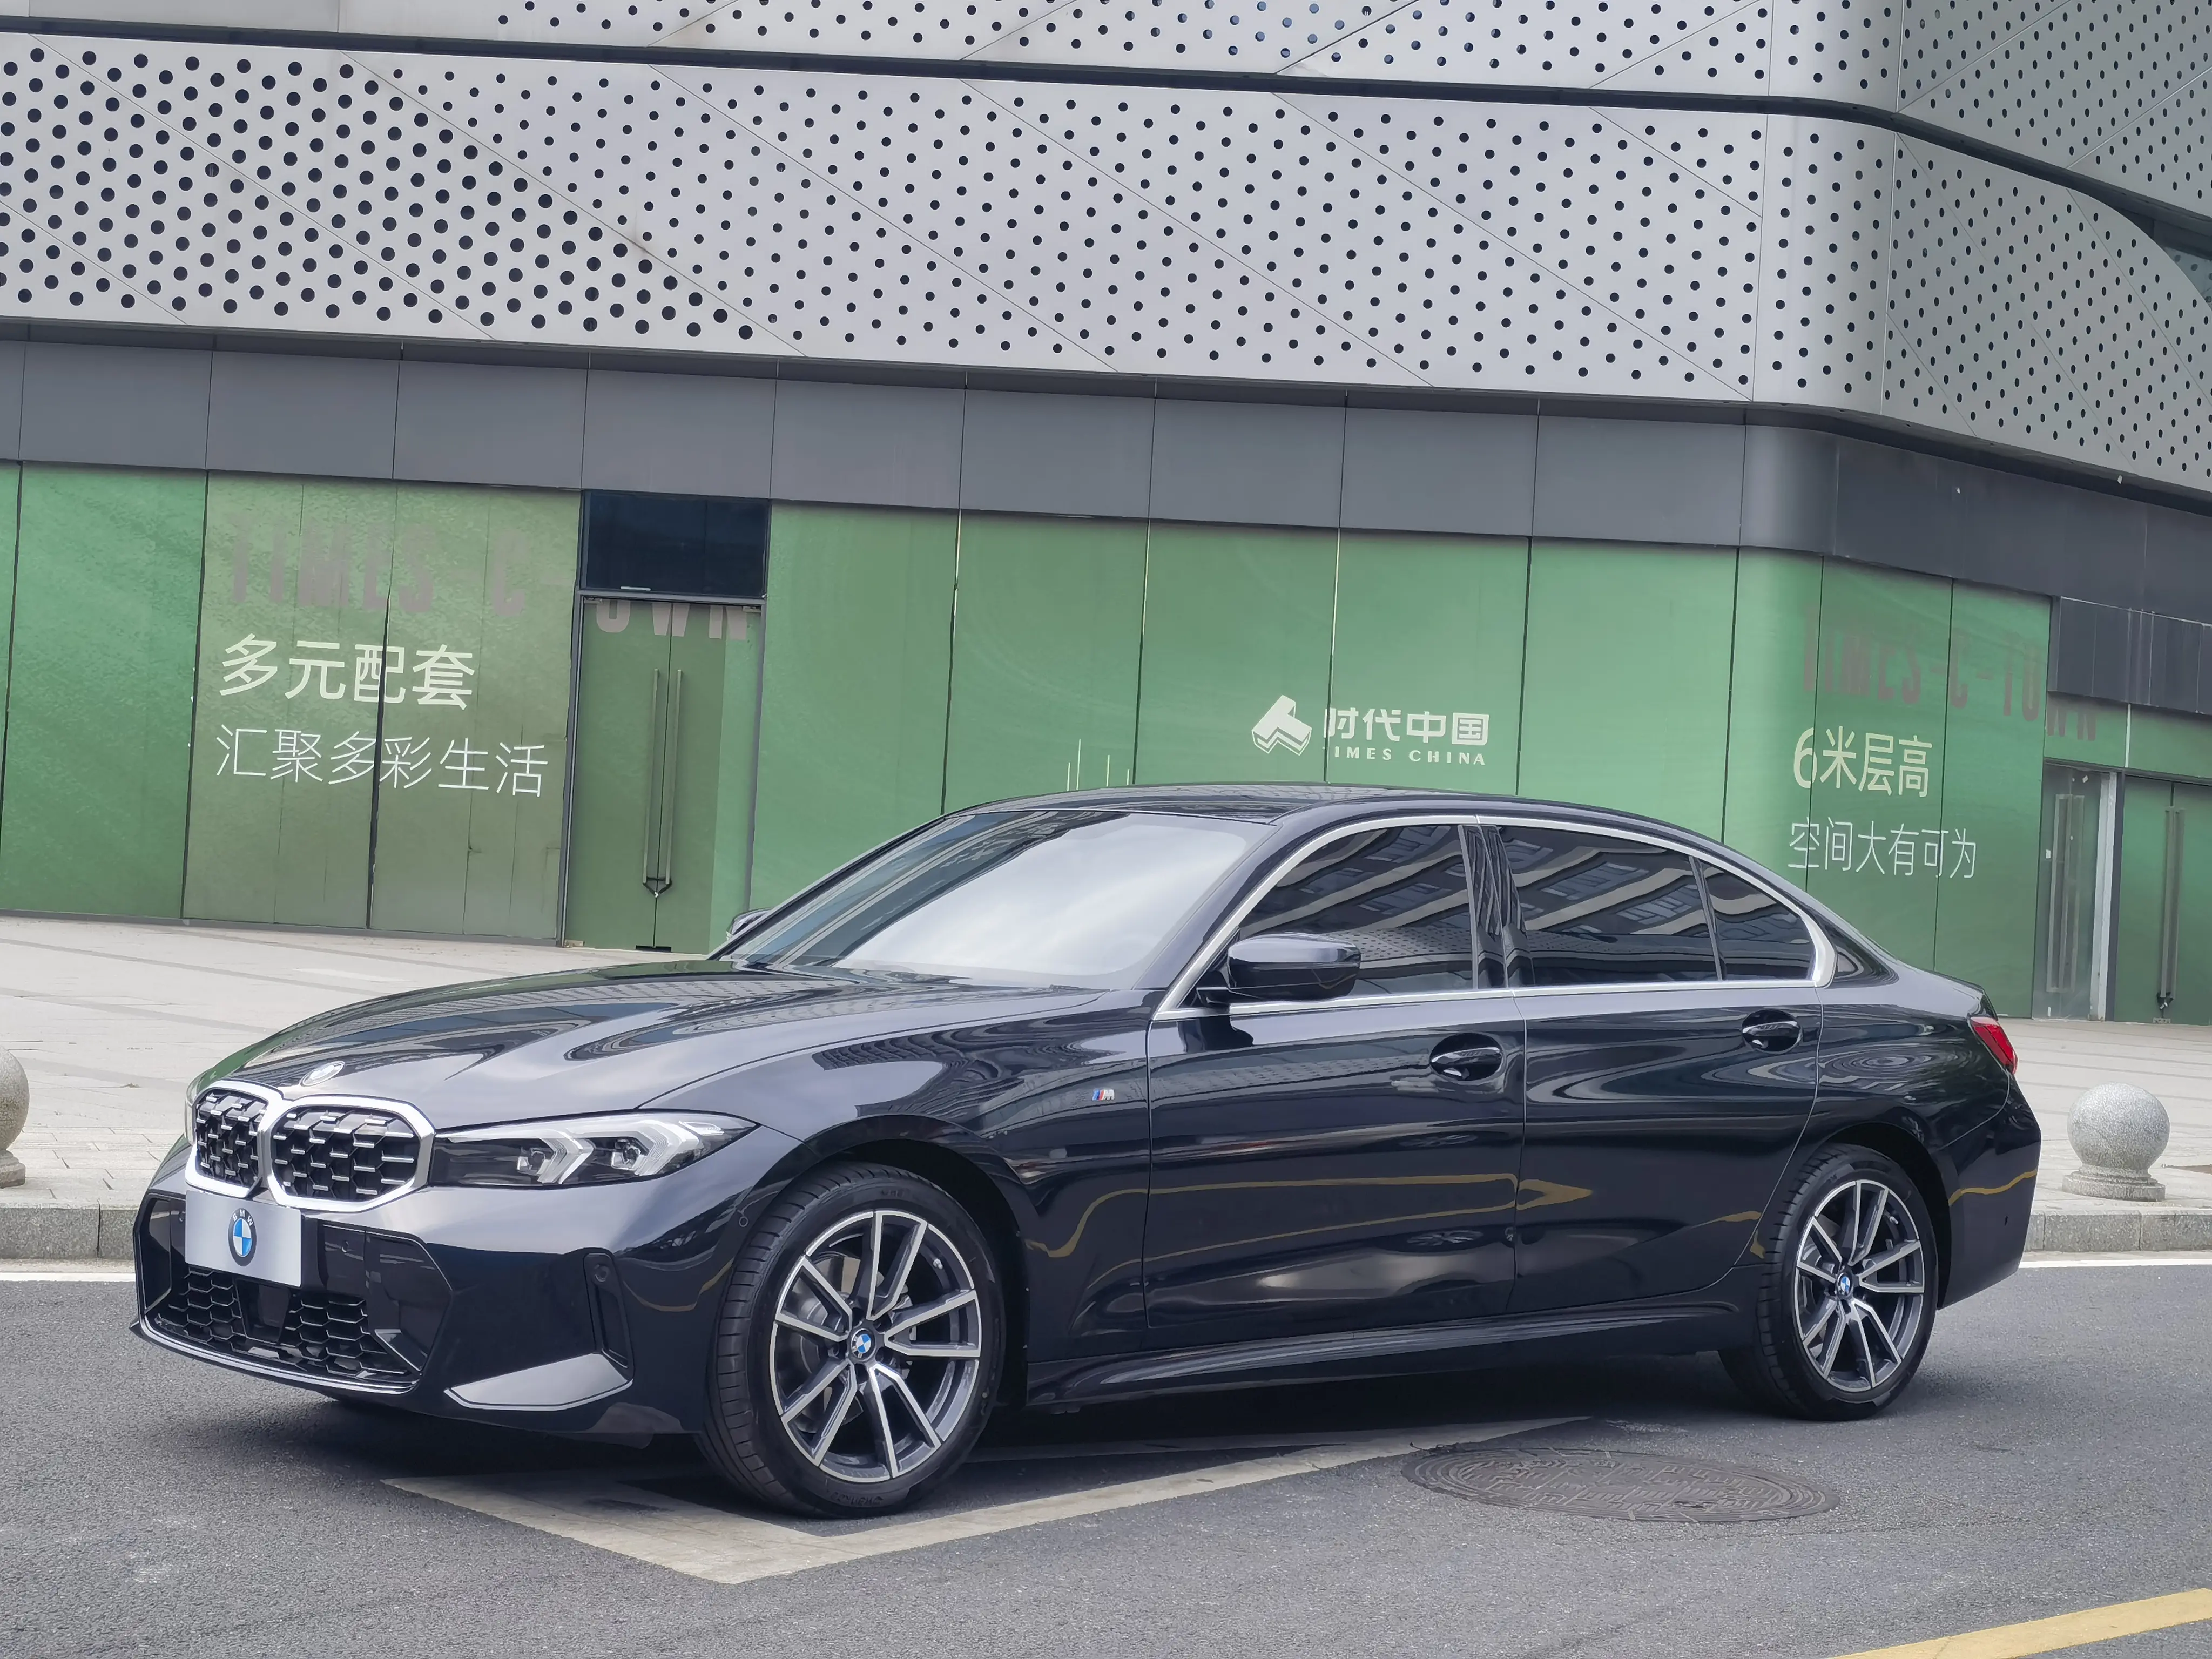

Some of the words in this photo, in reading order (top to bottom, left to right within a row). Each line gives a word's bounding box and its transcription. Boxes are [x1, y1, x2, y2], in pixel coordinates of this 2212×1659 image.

[218, 632, 475, 710] 多元配套
[1323, 706, 1489, 745] 时代中国
[1323, 746, 1392, 761] IMES
[1408, 750, 1486, 766] CHINA
[215, 723, 548, 798] 汇聚多彩生活
[1793, 725, 1933, 798] 6米层高
[1788, 816, 1977, 879] 空间大有可为
[232, 1209, 254, 1227] BMW
